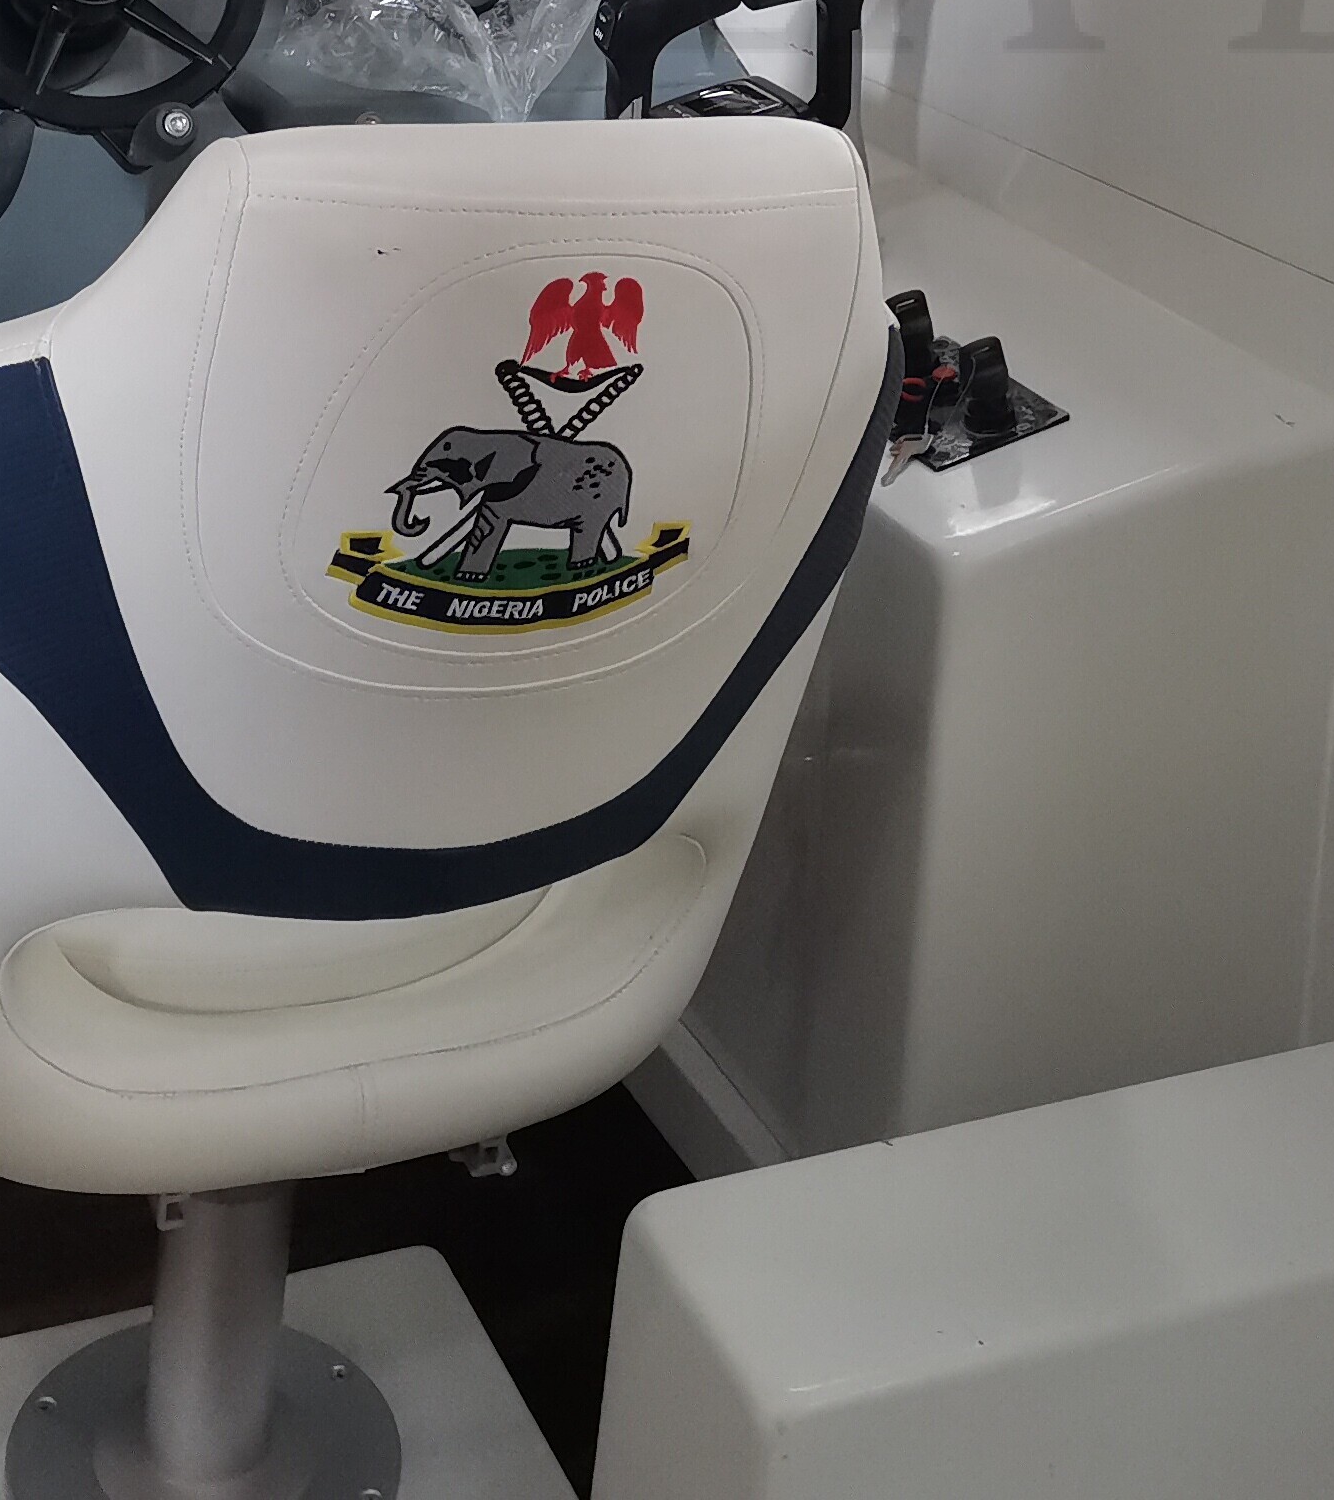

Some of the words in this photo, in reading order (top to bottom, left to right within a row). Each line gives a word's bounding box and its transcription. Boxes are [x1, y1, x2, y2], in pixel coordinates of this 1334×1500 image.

[375, 582, 426, 611] THE
[446, 597, 545, 620] NIGERIA
[571, 567, 653, 613] POLICE
